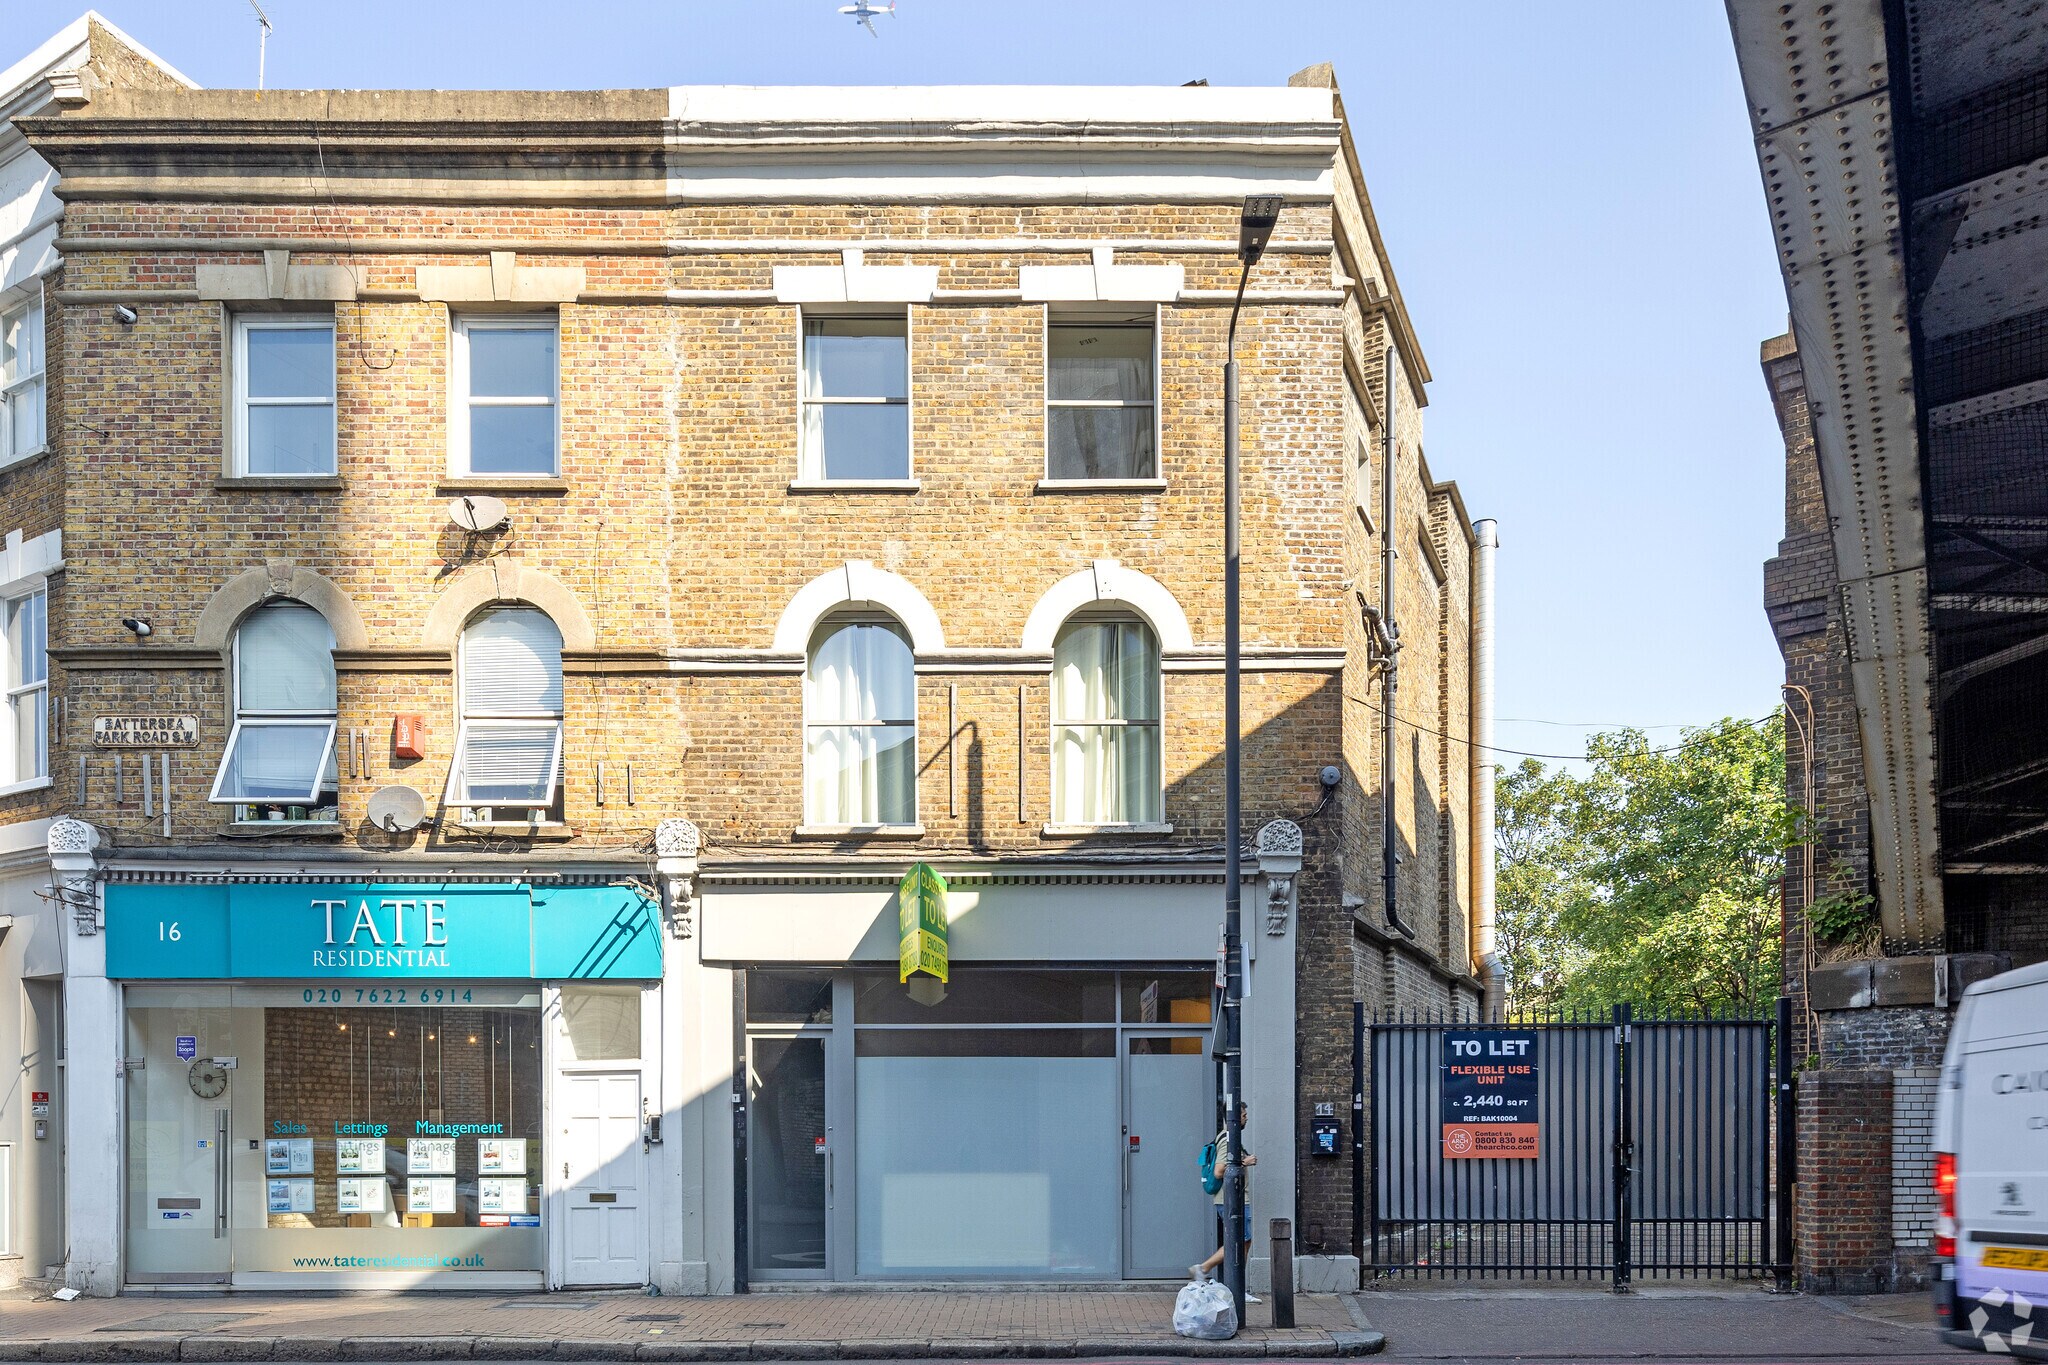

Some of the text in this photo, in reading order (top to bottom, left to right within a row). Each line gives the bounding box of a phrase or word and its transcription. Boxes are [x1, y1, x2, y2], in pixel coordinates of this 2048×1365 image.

[105, 718, 185, 730] BATTERSEA
[95, 731, 131, 744] PARK
[133, 731, 169, 743] ROAD
[924, 896, 935, 924] TO
[311, 899, 448, 945] TATE
[160, 921, 181, 941] 16
[313, 950, 450, 967] RESIDENTIAL
[303, 988, 472, 1003] 020 7622 6914
[1451, 1040, 1530, 1056] TO LET
[1451, 1065, 1531, 1075] FLEXIBLE USE
[1477, 1076, 1505, 1085] UNIT
[1315, 1103, 1334, 1115] 14
[1463, 1095, 1503, 1109] 2,440
[273, 1121, 307, 1134] Sales
[335, 1121, 388, 1137] Lettings
[416, 1120, 503, 1137] Management
[293, 1253, 484, 1267] www.tateresidential.co.uk
